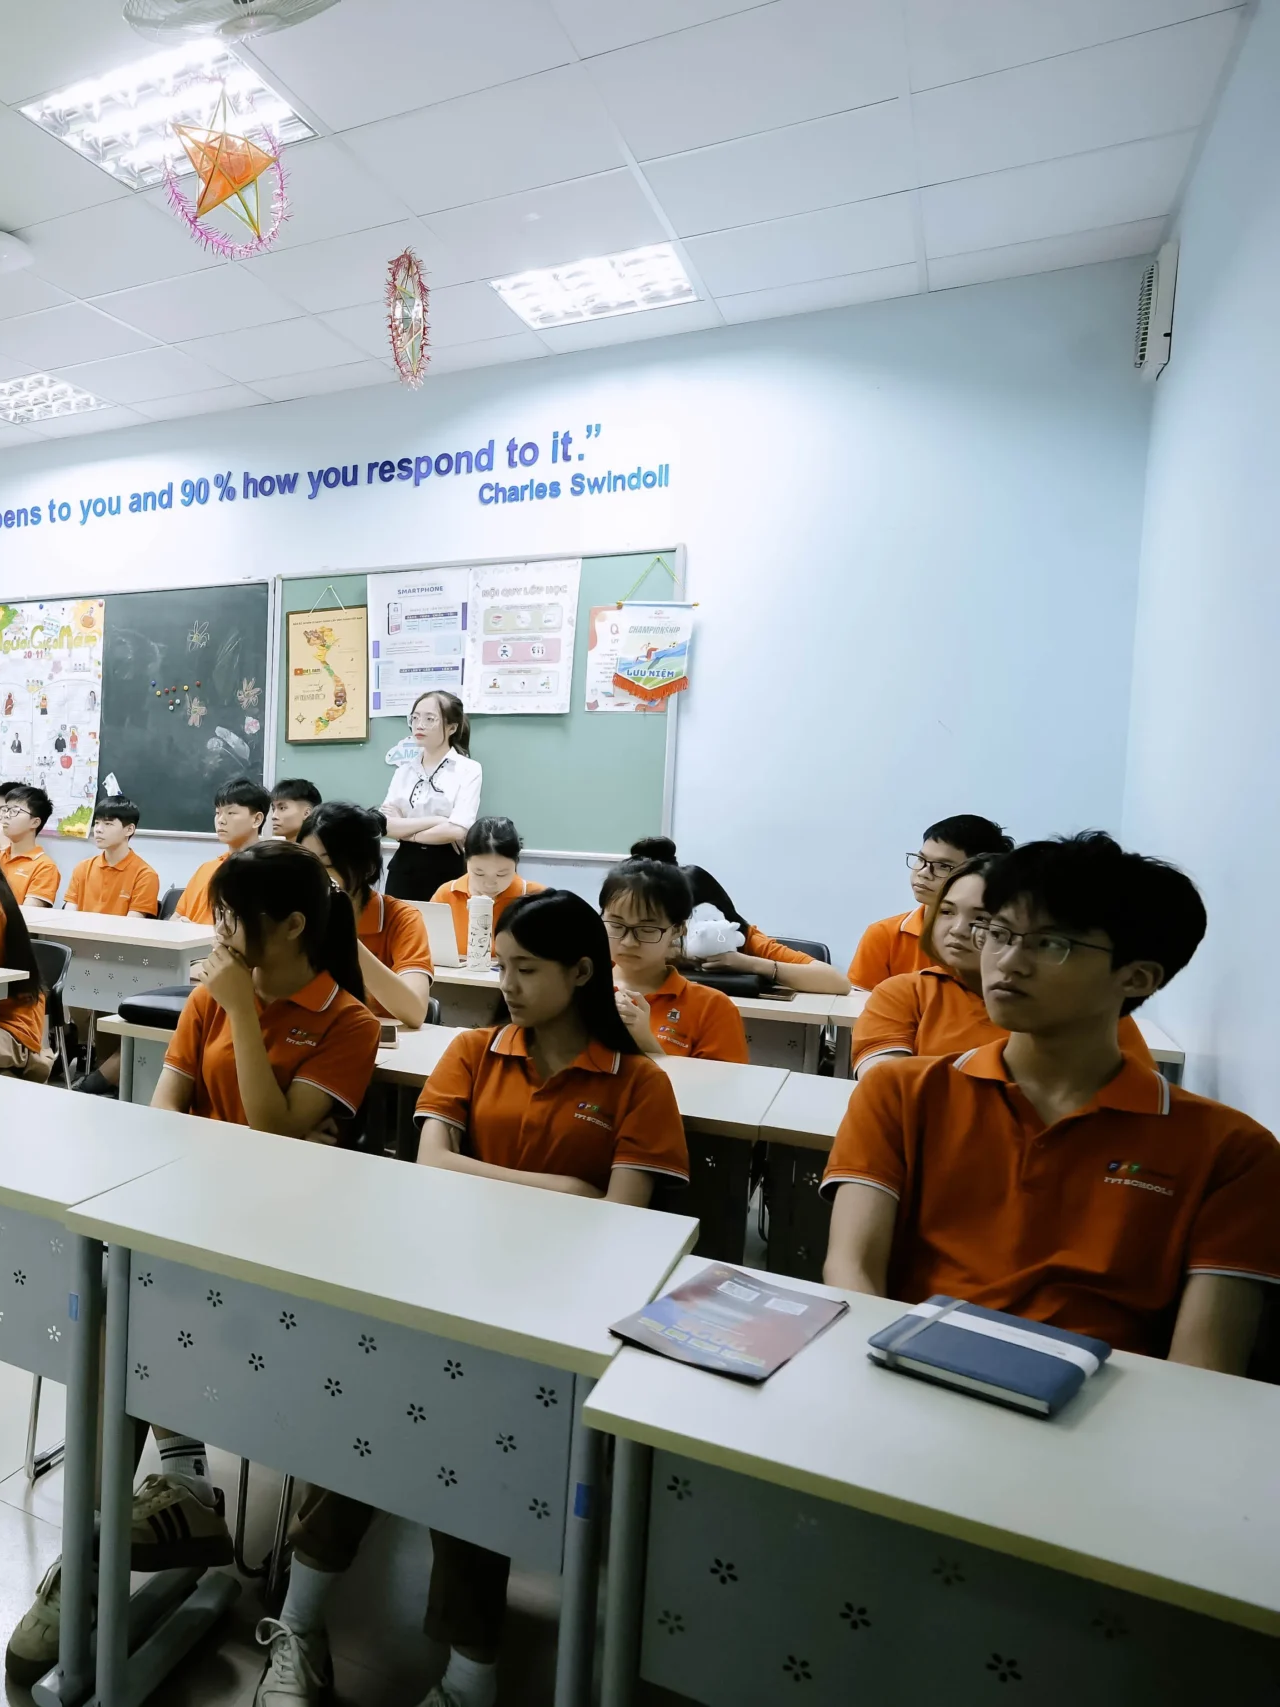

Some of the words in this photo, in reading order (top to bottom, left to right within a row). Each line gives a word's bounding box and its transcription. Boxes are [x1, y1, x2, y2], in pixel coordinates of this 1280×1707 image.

[48, 499, 71, 523] to
[79, 495, 121, 525] you
[128, 482, 173, 513] and
[243, 470, 299, 499] how
[307, 463, 359, 499] you
[366, 439, 495, 486] respond
[506, 437, 539, 468] to
[478, 474, 561, 505] Charles
[569, 463, 670, 497] Swindoll
[397, 585, 444, 595] SMARTPHONE
[628, 625, 681, 635] CHAMPIONSHIP
[1103, 1176, 1124, 1184] FPT
[1123, 1179, 1175, 1197] SCHOOLS
